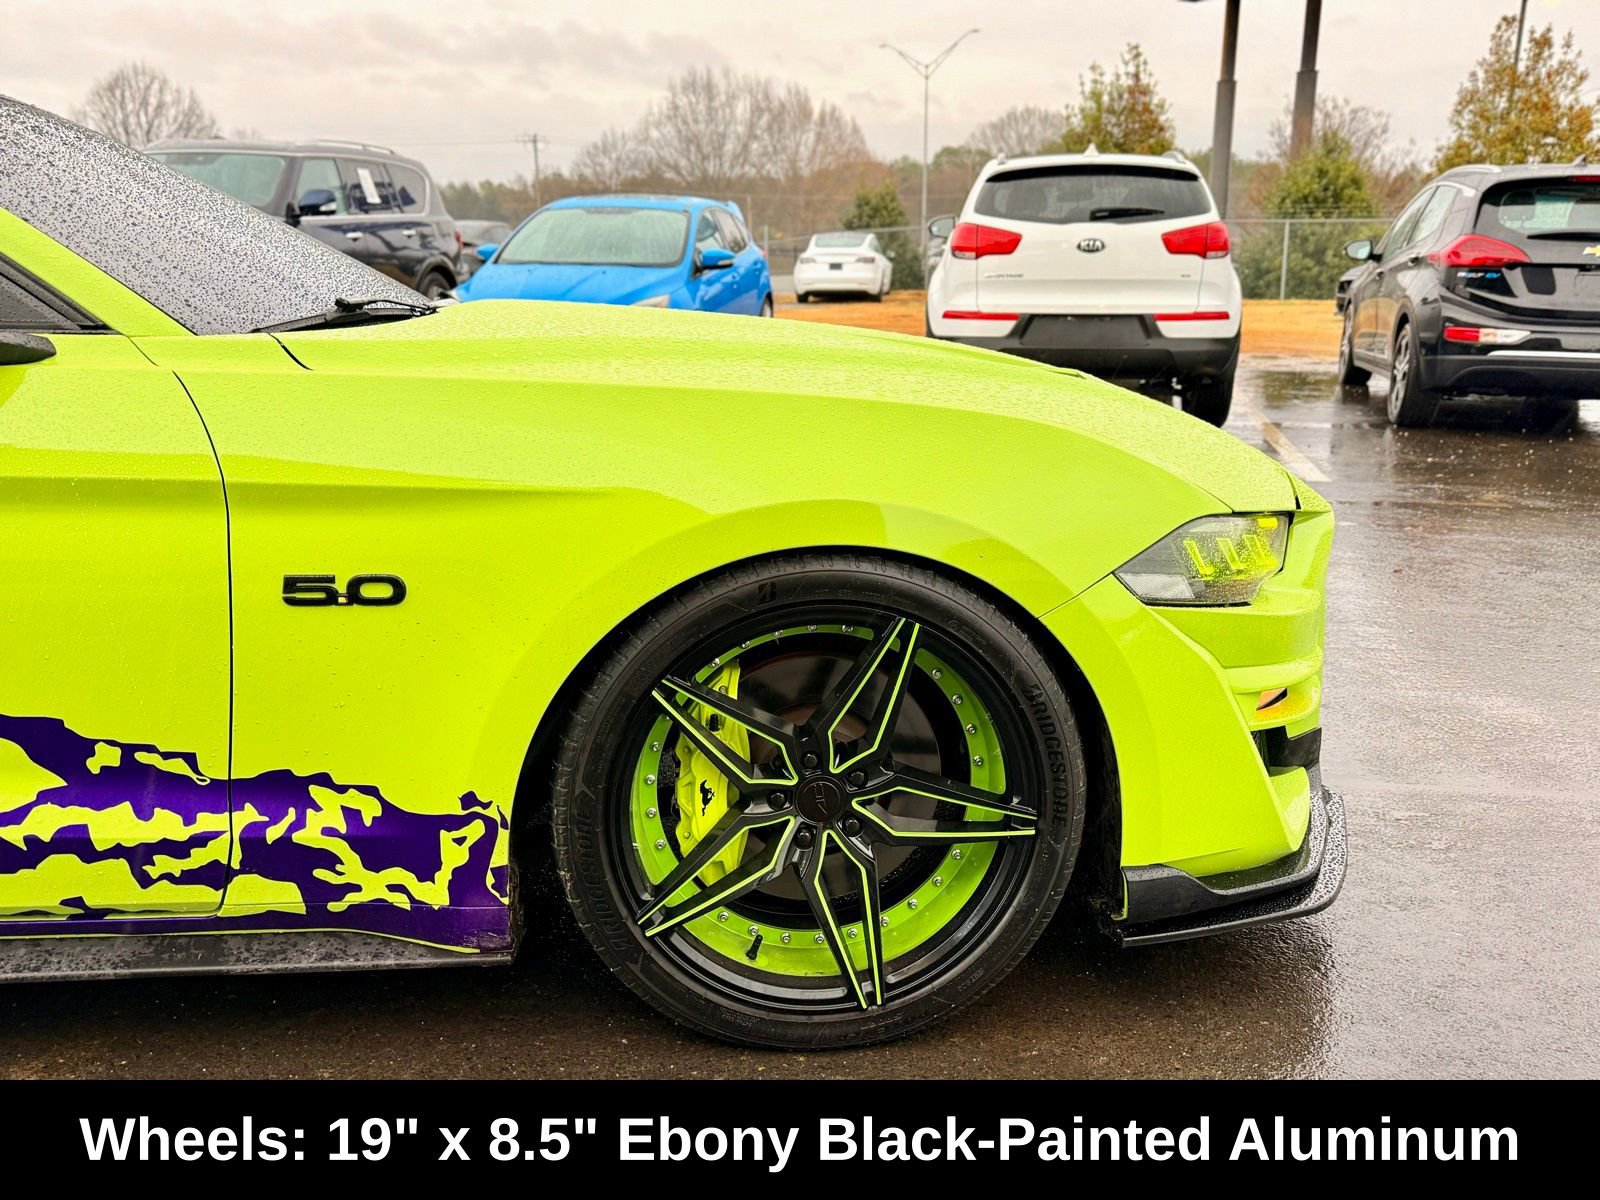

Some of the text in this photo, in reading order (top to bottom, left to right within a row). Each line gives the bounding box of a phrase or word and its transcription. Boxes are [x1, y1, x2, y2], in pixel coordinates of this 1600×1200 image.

[1079, 239, 1103, 251] KIA
[281, 573, 407, 607] 5.0
[1024, 684, 1069, 828] BRIDGESTONE
